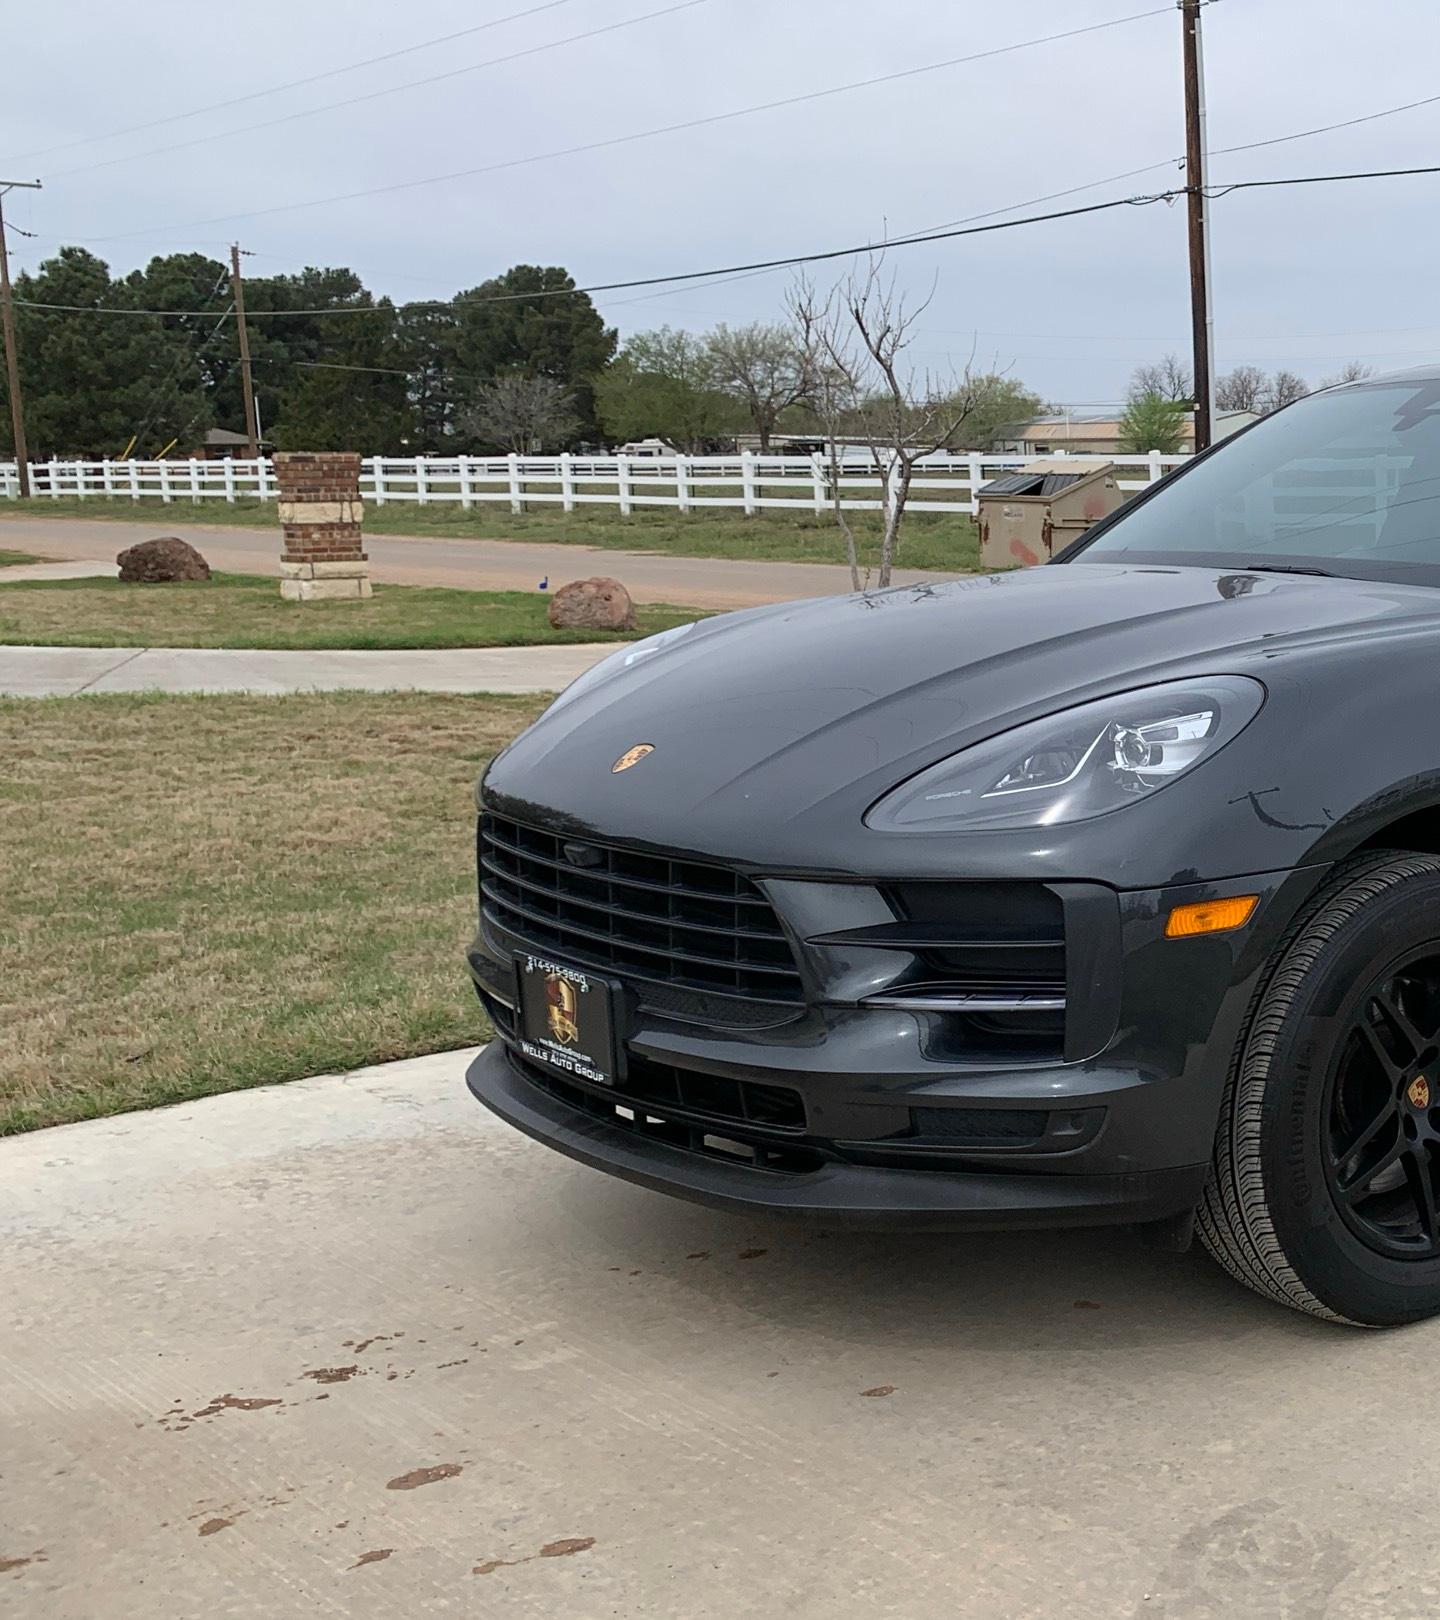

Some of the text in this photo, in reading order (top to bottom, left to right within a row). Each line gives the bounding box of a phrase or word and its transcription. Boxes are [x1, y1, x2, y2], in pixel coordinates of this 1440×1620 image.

[925, 789, 972, 801] PORSCHE
[550, 1054, 573, 1070] AUTO
[575, 1063, 604, 1082] GROUP
